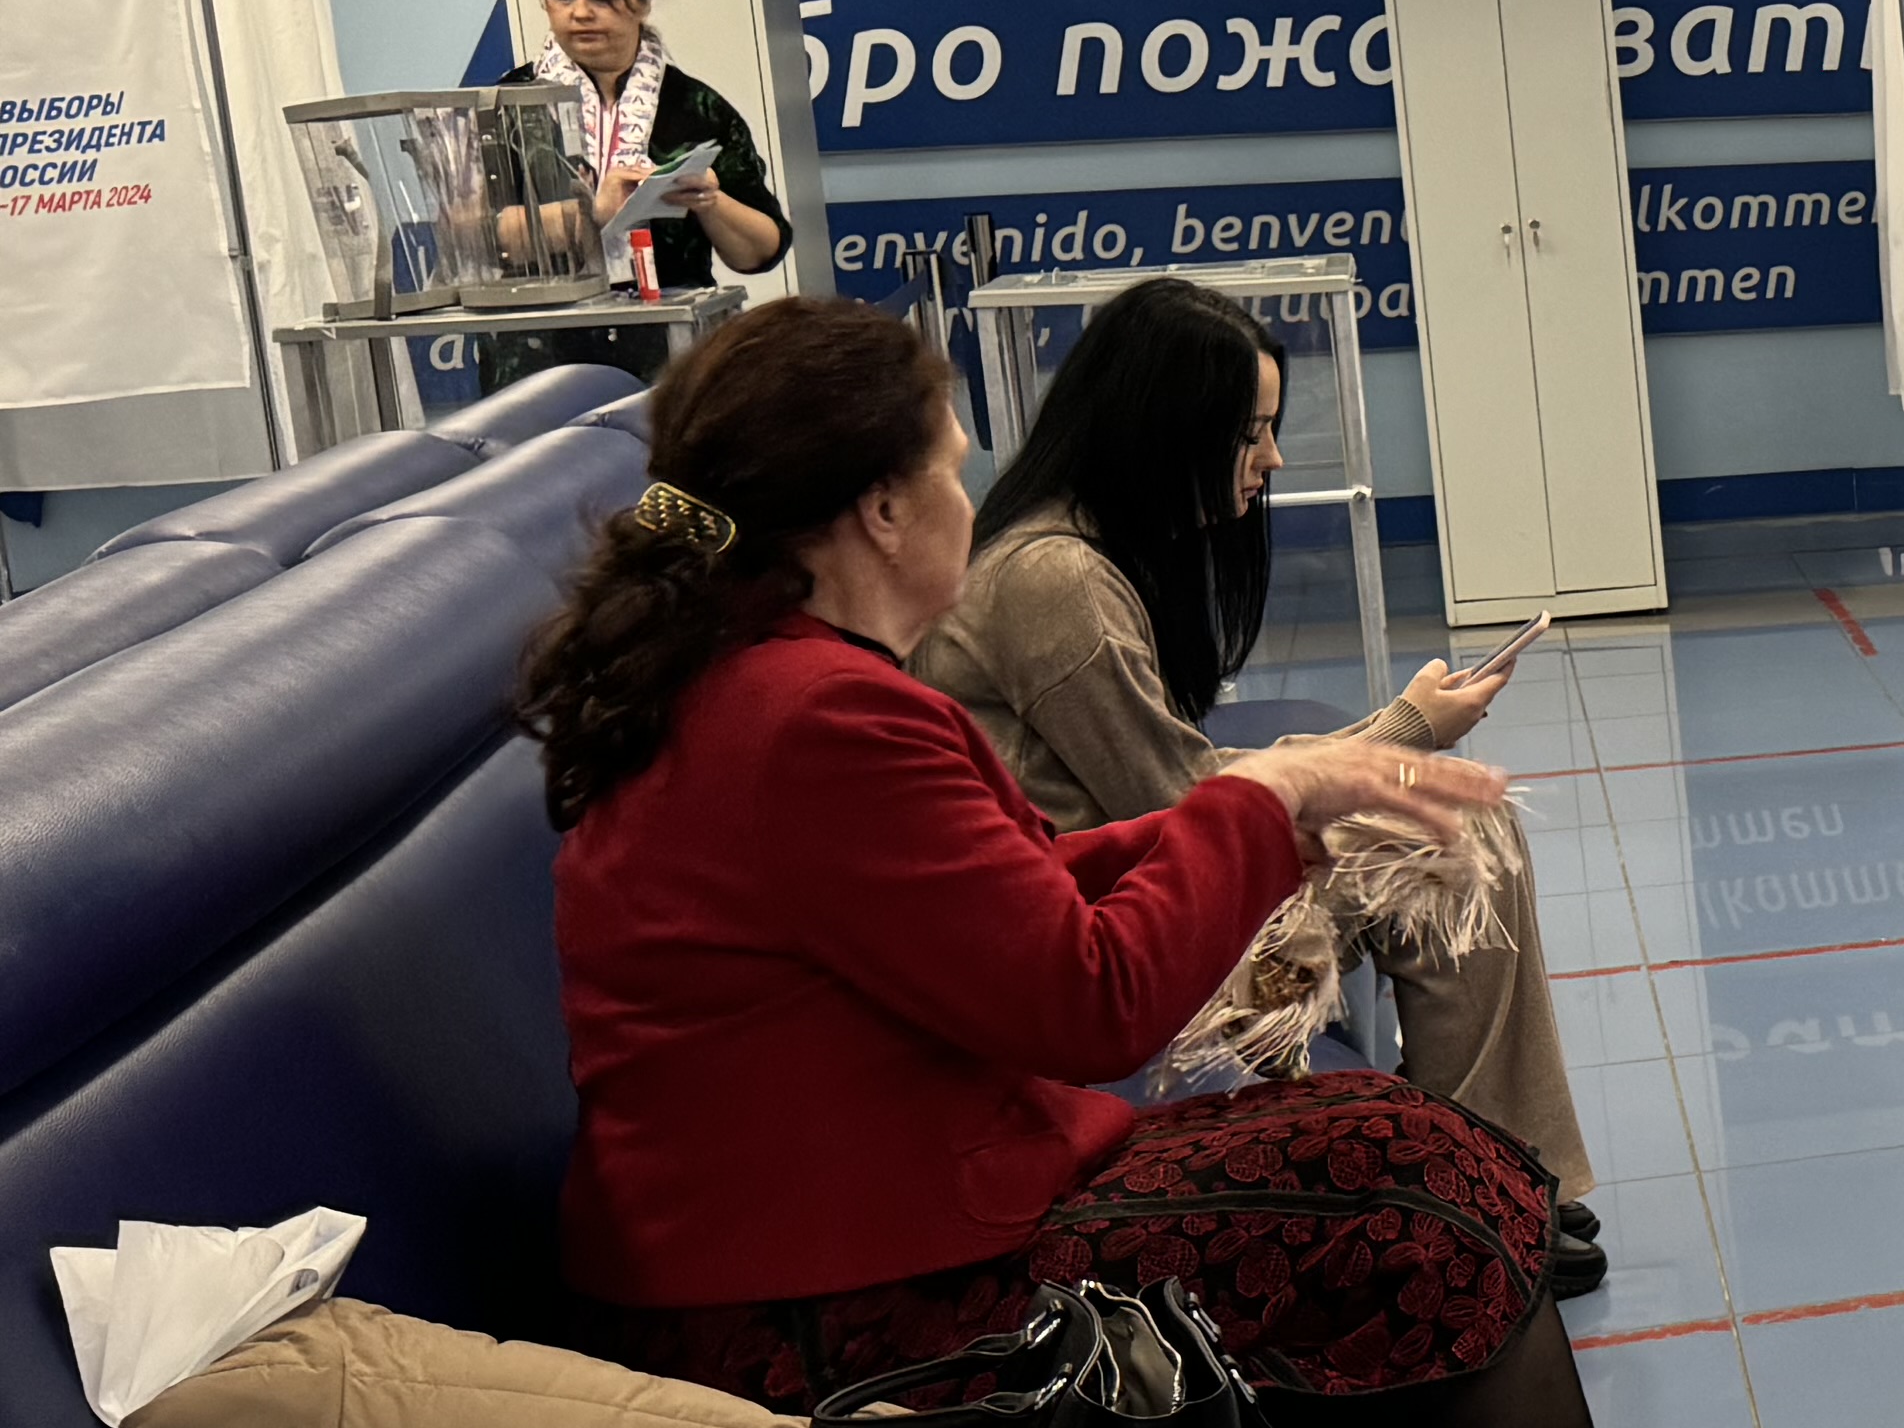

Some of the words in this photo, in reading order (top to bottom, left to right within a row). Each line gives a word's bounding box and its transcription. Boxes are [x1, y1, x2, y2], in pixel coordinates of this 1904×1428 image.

[0, 91, 124, 123] ВЫБОРЫ
[34, 188, 102, 215] МАРТА
[105, 183, 152, 208] 2024
[1172, 204, 1412, 254] benven
[1637, 184, 1878, 232] lkomme
